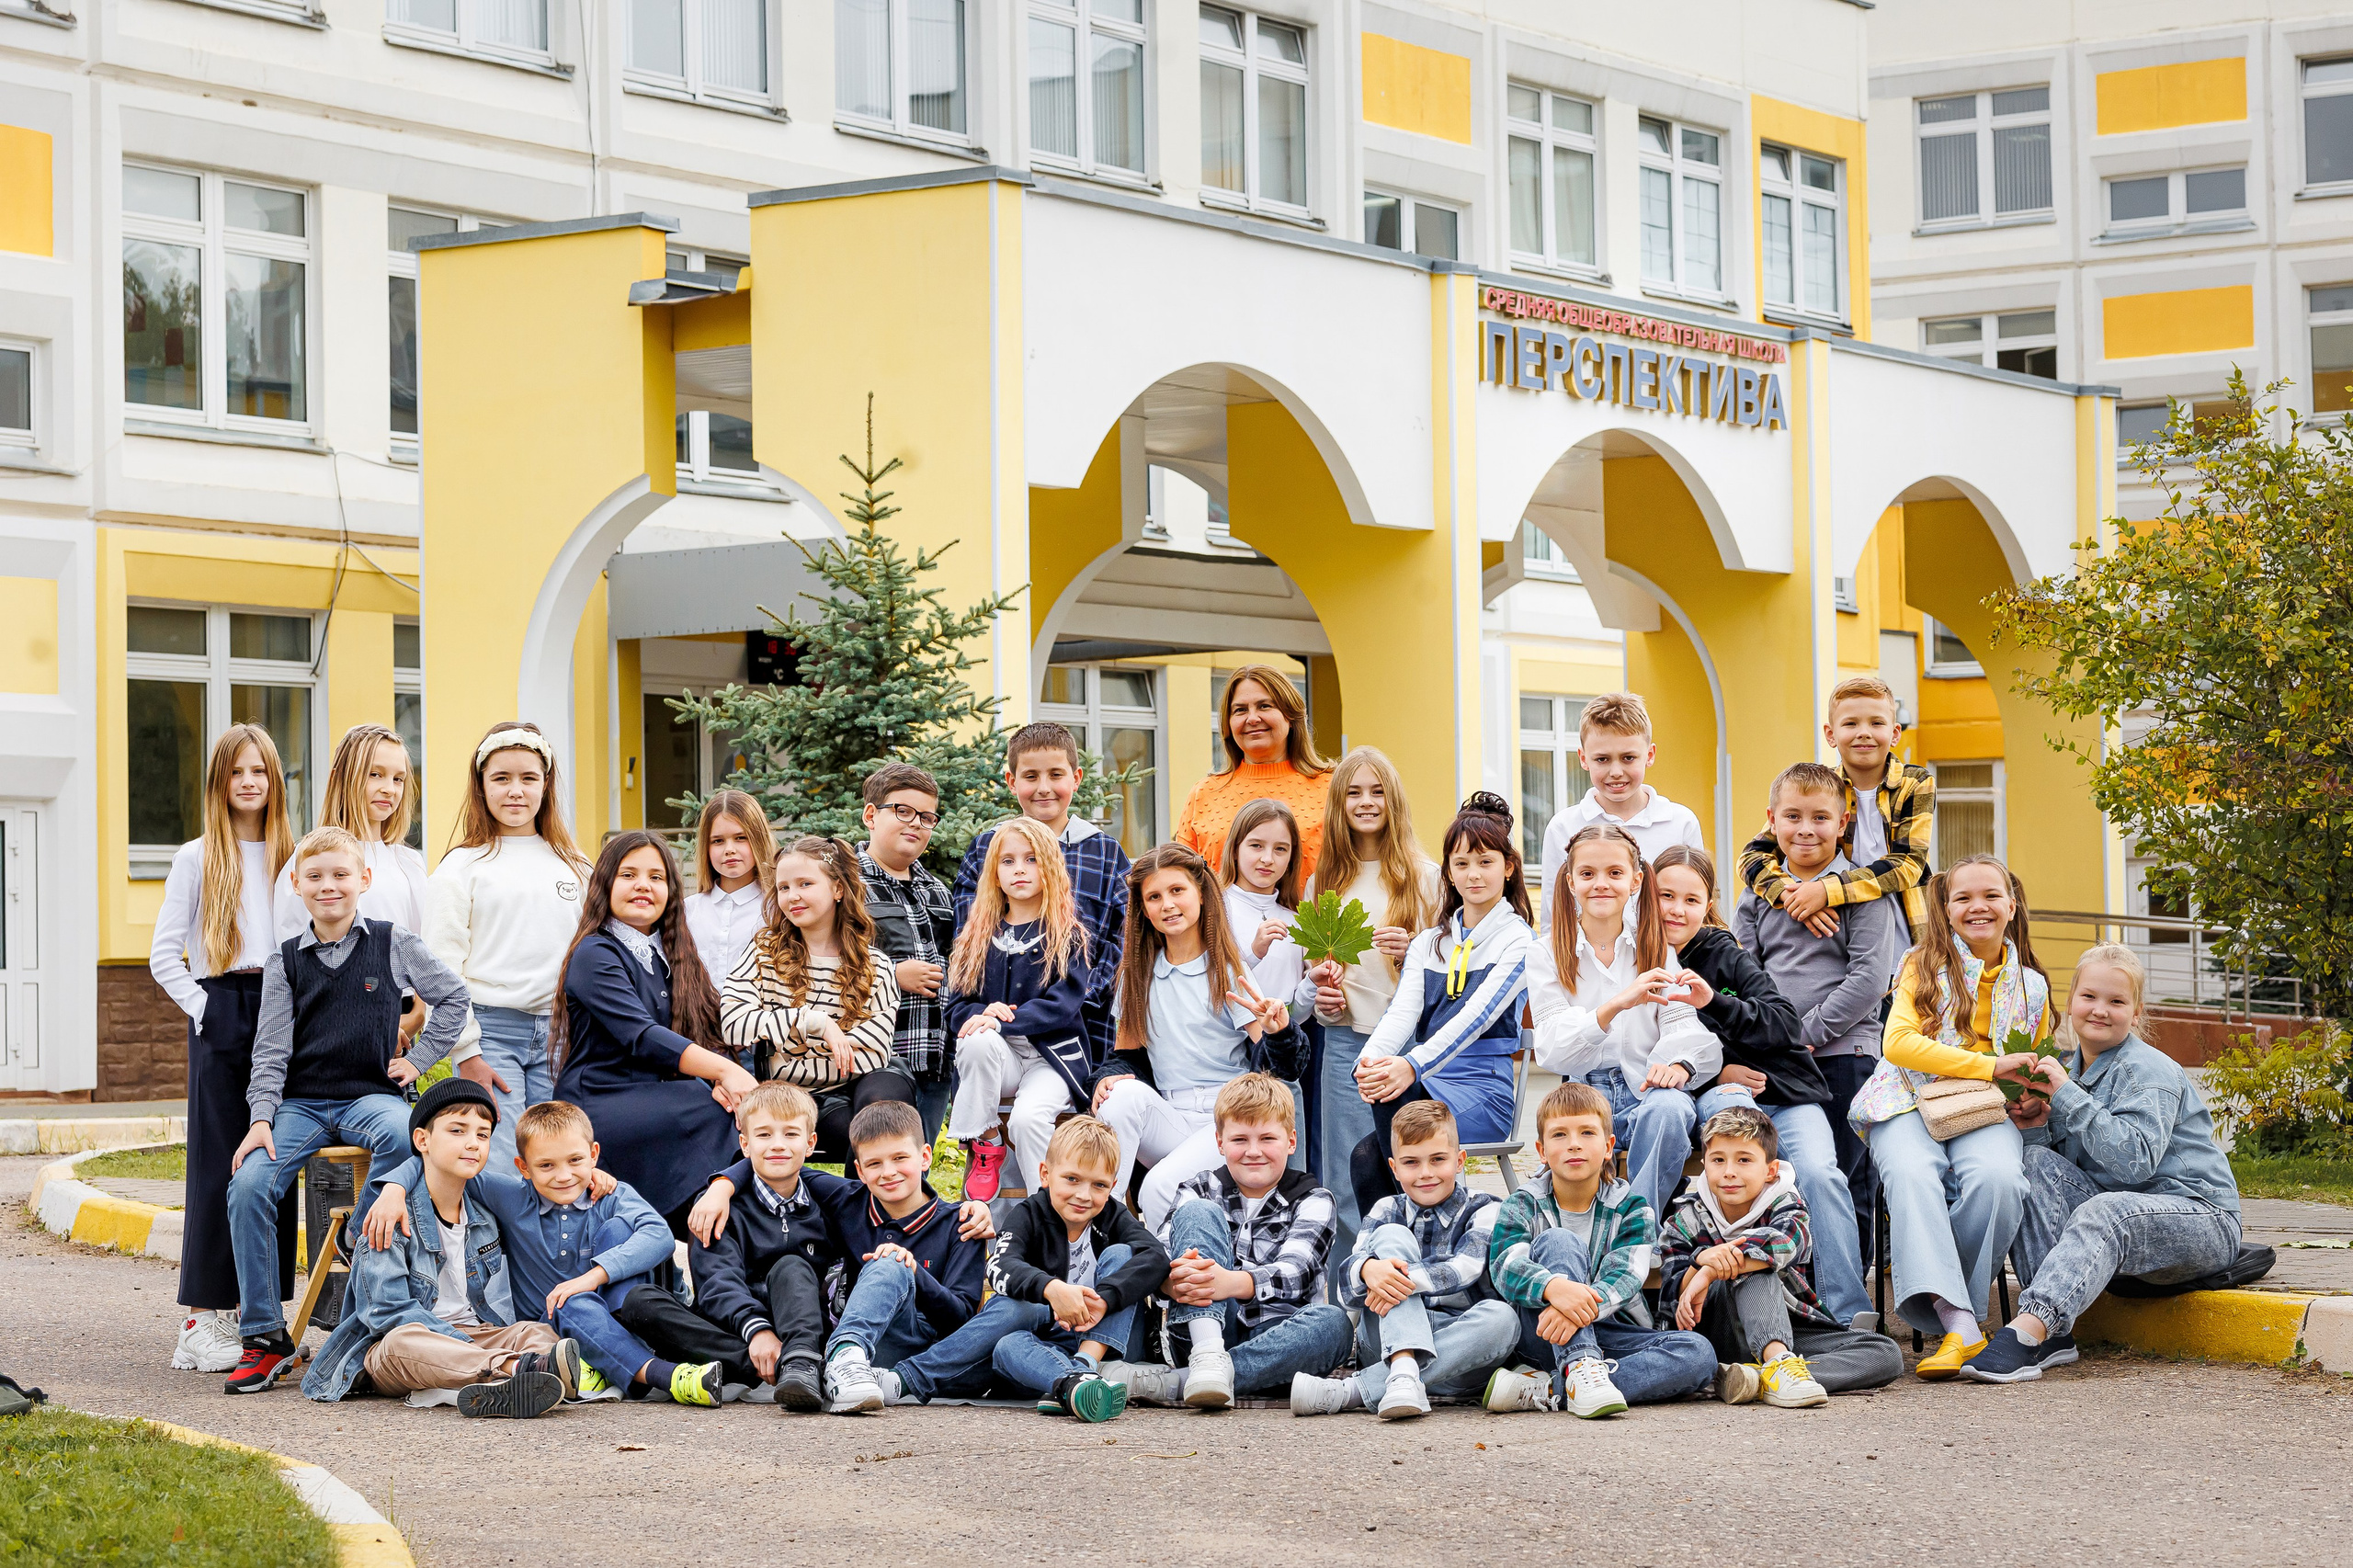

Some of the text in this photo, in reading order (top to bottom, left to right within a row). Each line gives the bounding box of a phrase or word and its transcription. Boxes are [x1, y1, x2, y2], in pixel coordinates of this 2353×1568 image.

[1485, 287, 1787, 364] СРЕДНЯЯ ОБЩЕОБРАЗОВАТЕЛЬНАЯ ШКОЛА
[1485, 320, 1787, 431] ПЕРСПЕКТИВА
